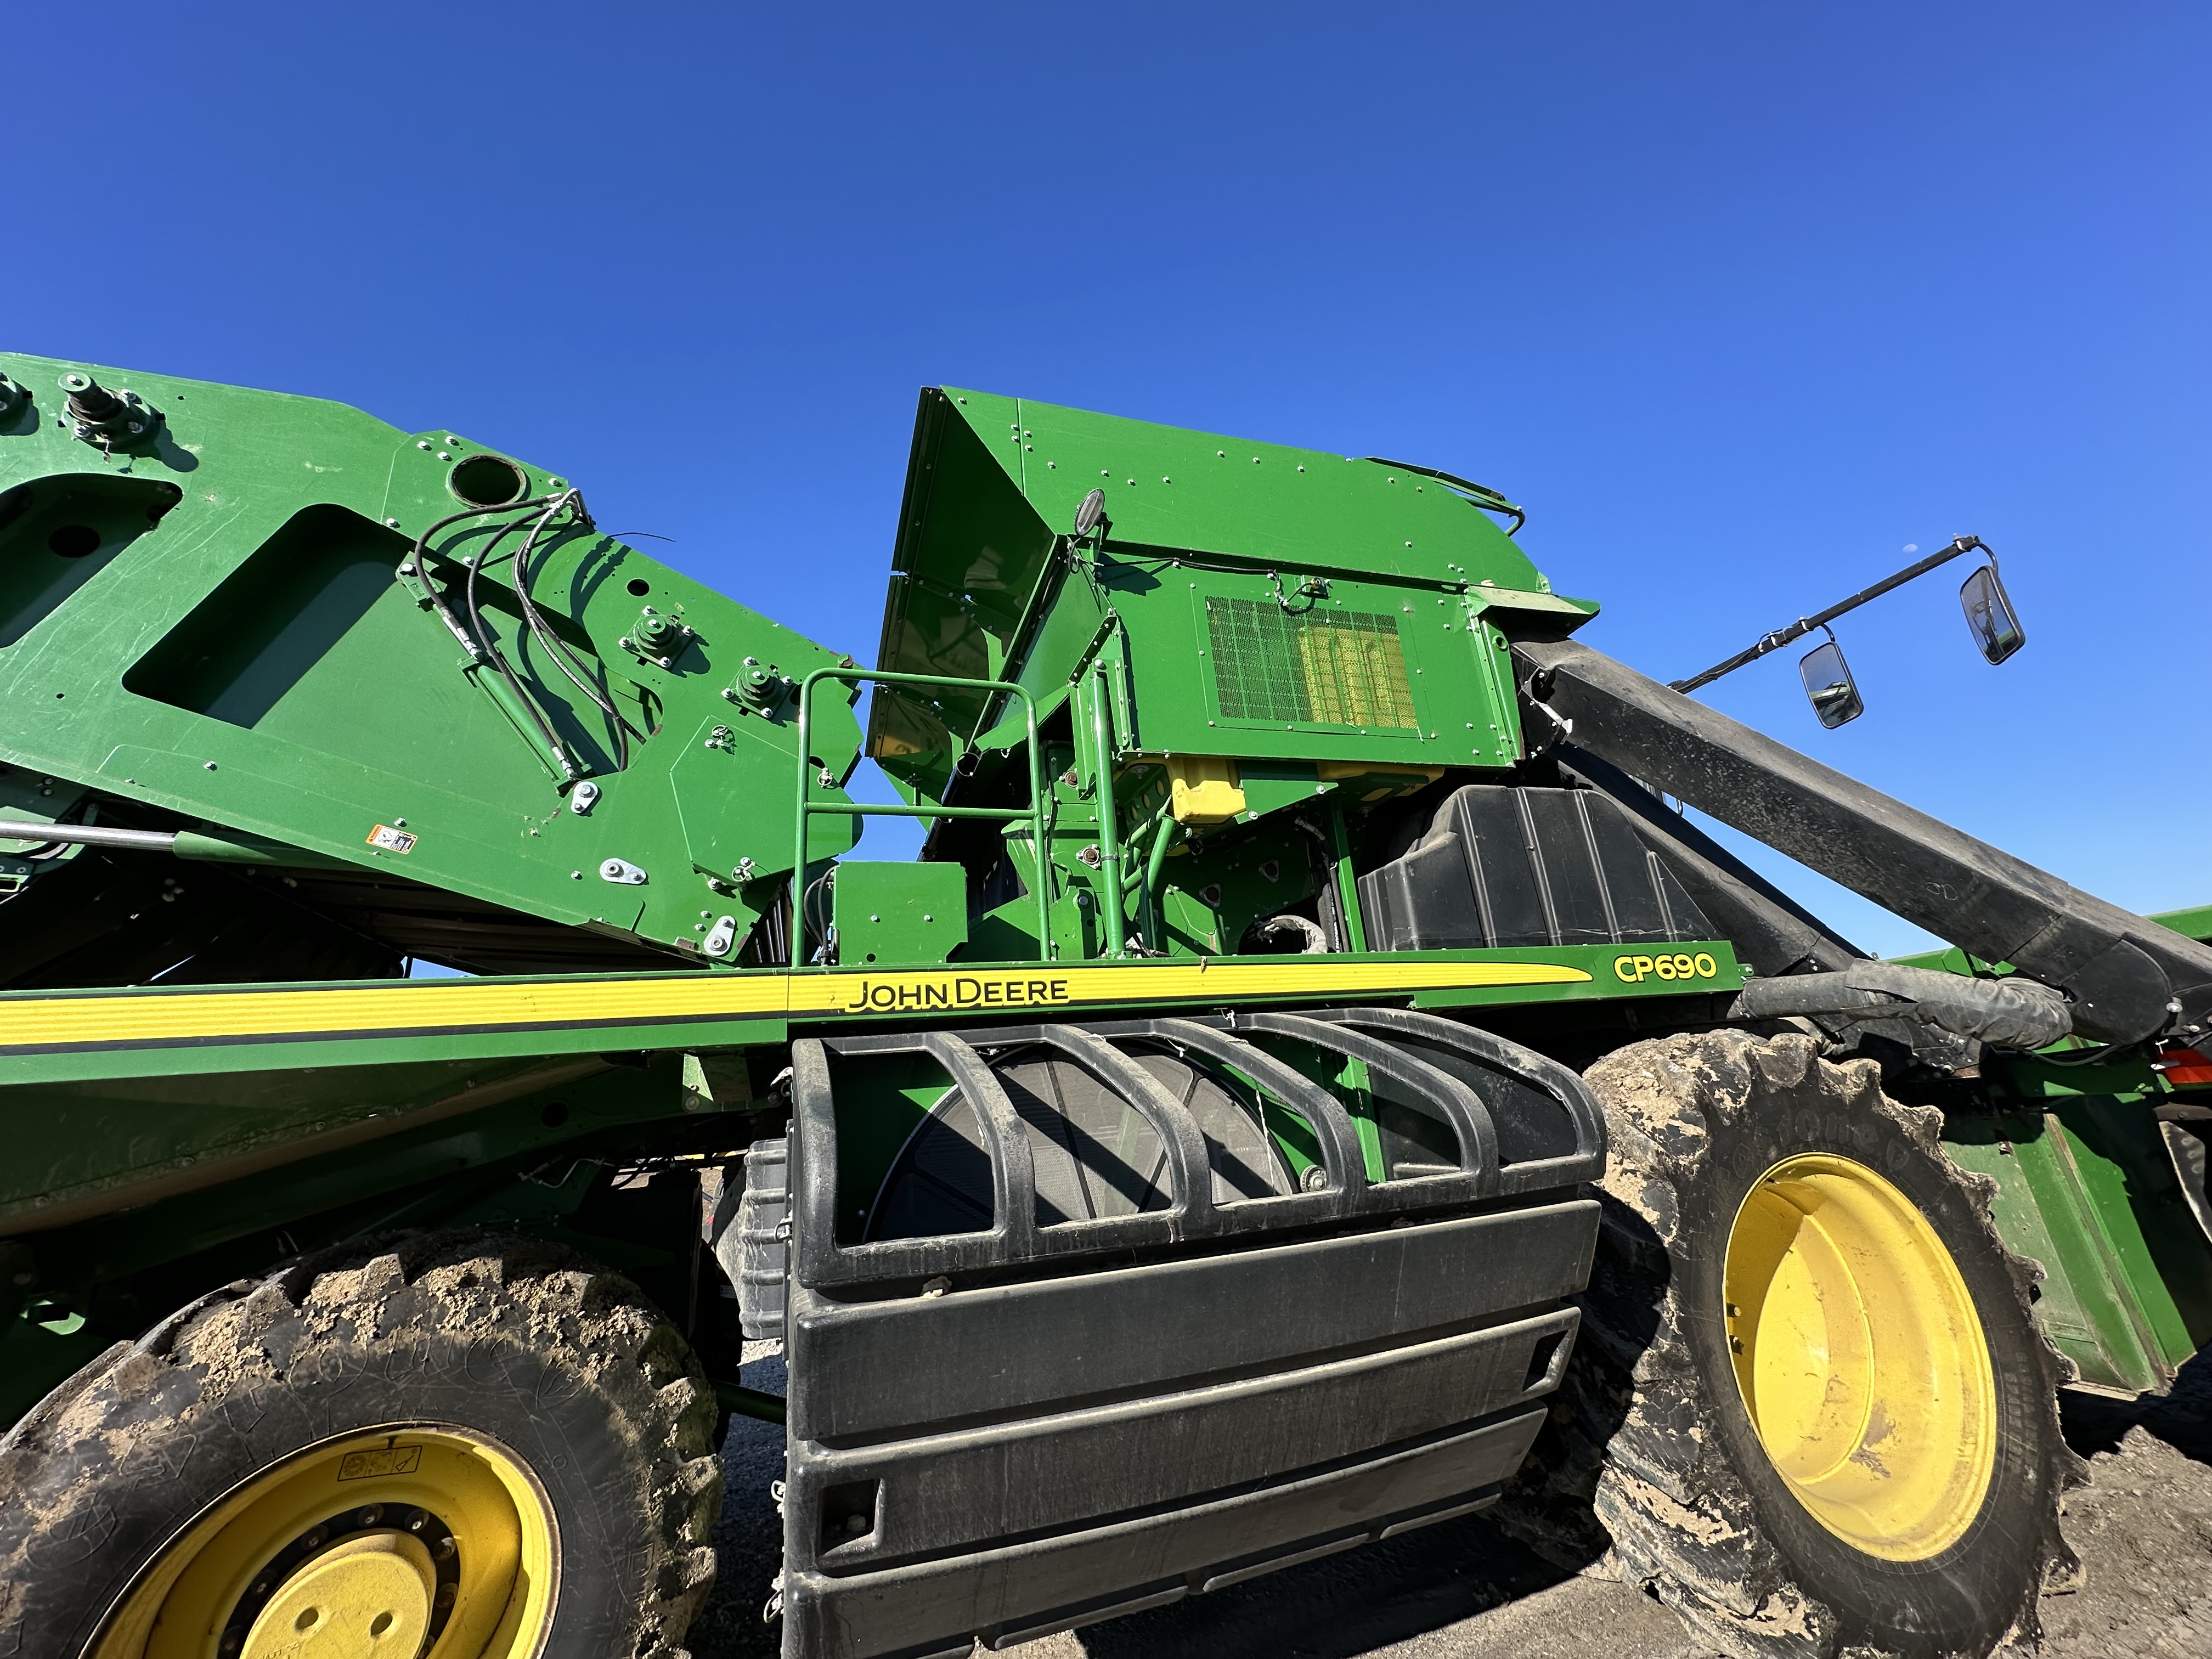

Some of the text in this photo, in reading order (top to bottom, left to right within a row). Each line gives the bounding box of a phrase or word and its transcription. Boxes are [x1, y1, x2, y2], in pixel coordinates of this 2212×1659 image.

[1613, 952, 1717, 983] CP690
[850, 979, 1069, 1008] JOHN DEERE
